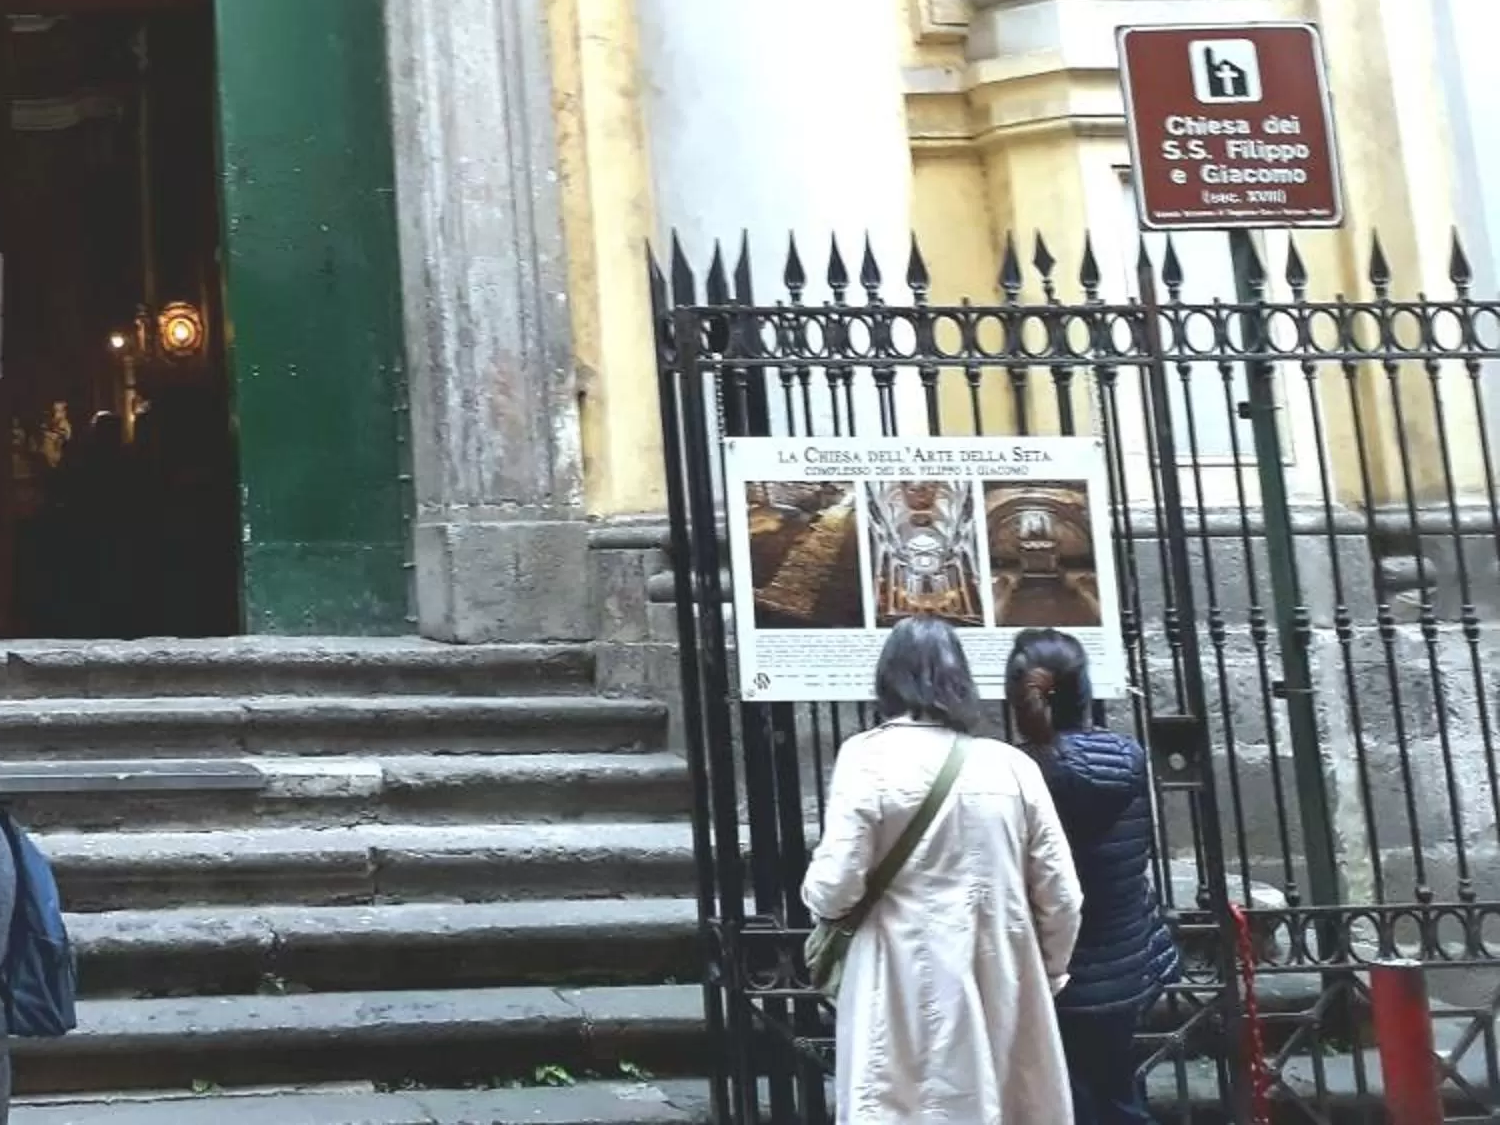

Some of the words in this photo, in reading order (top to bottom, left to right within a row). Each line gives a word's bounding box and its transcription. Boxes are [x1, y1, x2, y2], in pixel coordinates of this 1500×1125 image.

[1164, 115, 1251, 135] Chiesa
[1263, 115, 1301, 135] dei
[1161, 140, 1213, 160] S.S.
[1226, 140, 1311, 163] Filippo
[1170, 169, 1187, 184] e
[1202, 164, 1307, 184] Giacomo
[959, 450, 1007, 463] DELLA
[1012, 446, 1053, 463] SETA
